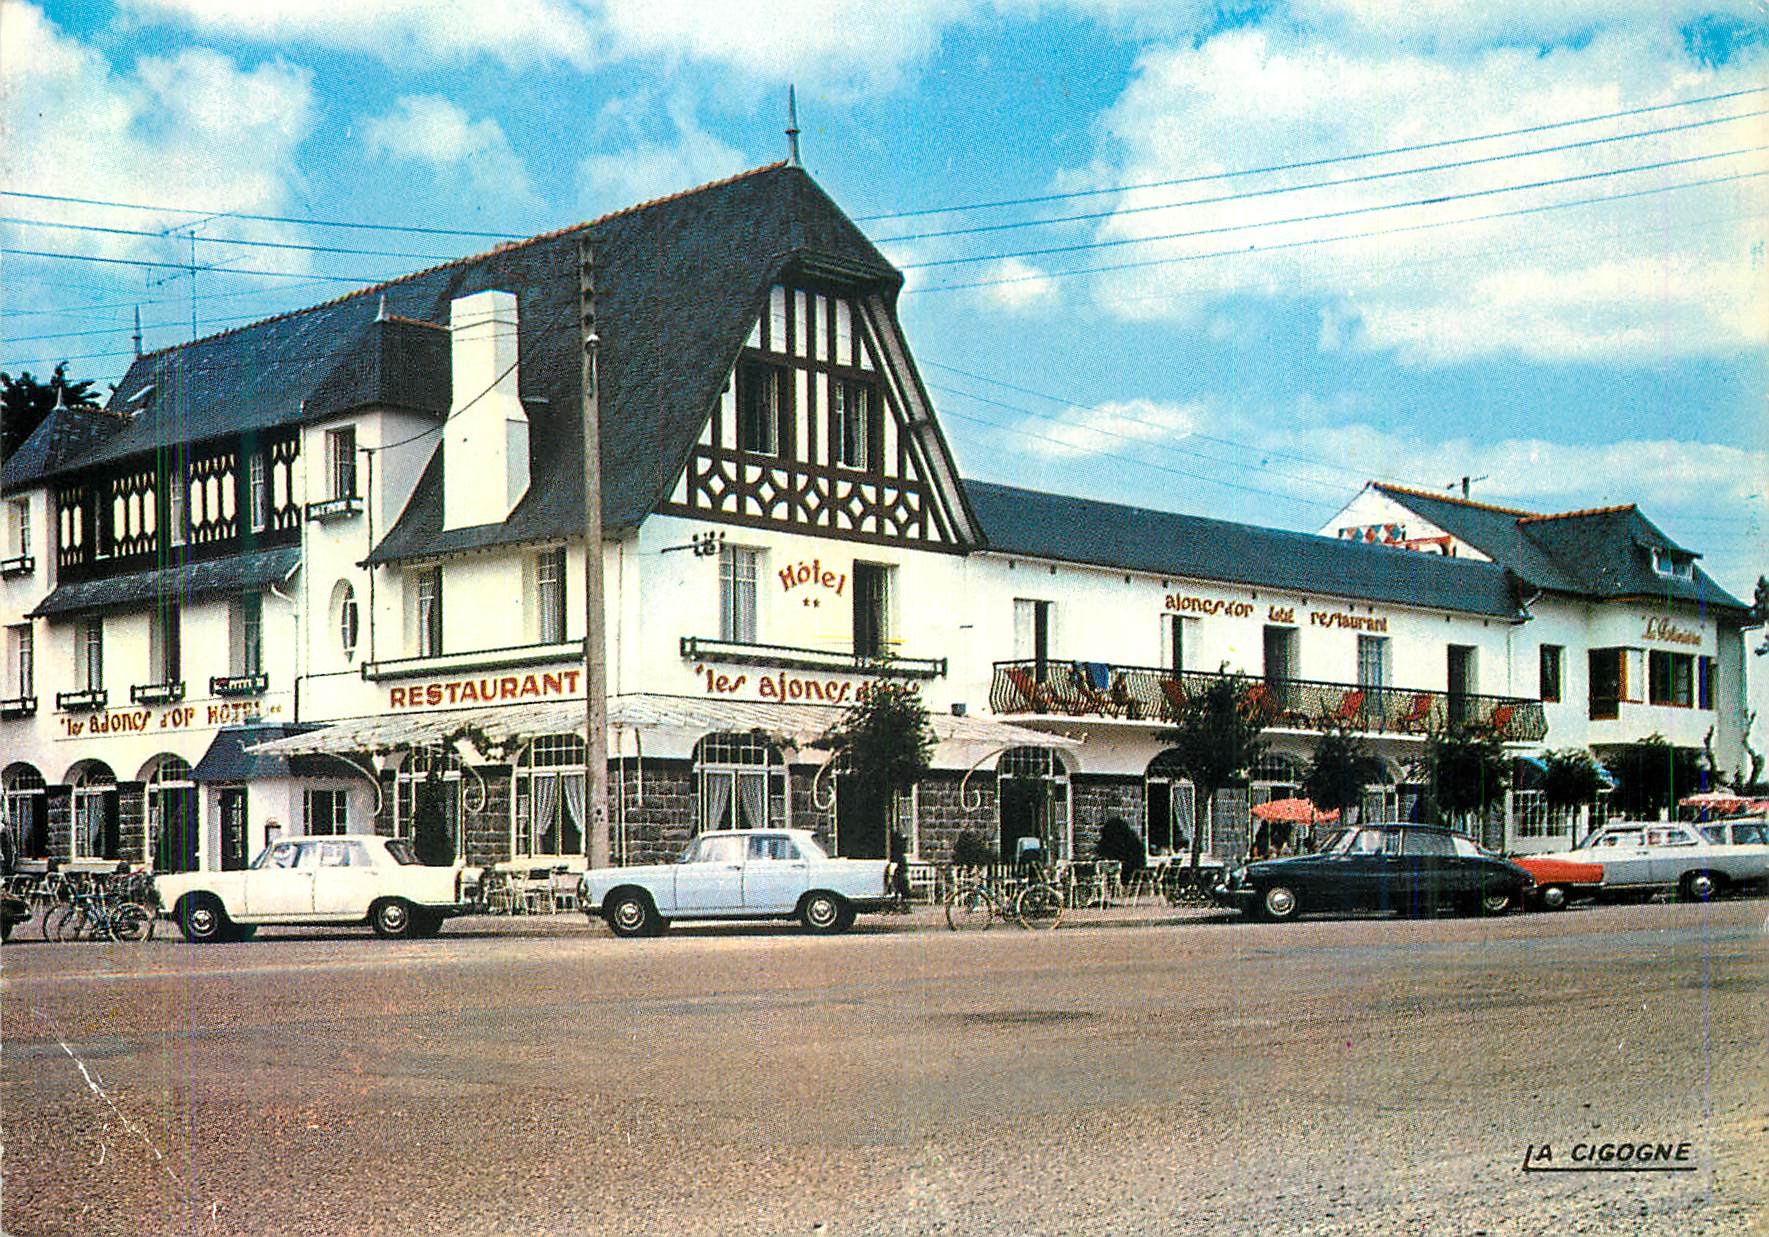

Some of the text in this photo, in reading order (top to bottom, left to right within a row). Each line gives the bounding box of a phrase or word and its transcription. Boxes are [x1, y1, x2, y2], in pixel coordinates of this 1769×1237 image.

[778, 558, 846, 597] Hôtel
[1310, 610, 1387, 632] restaurant
[389, 670, 580, 710] RESTAURANT
[758, 671, 850, 704] ajoncs
